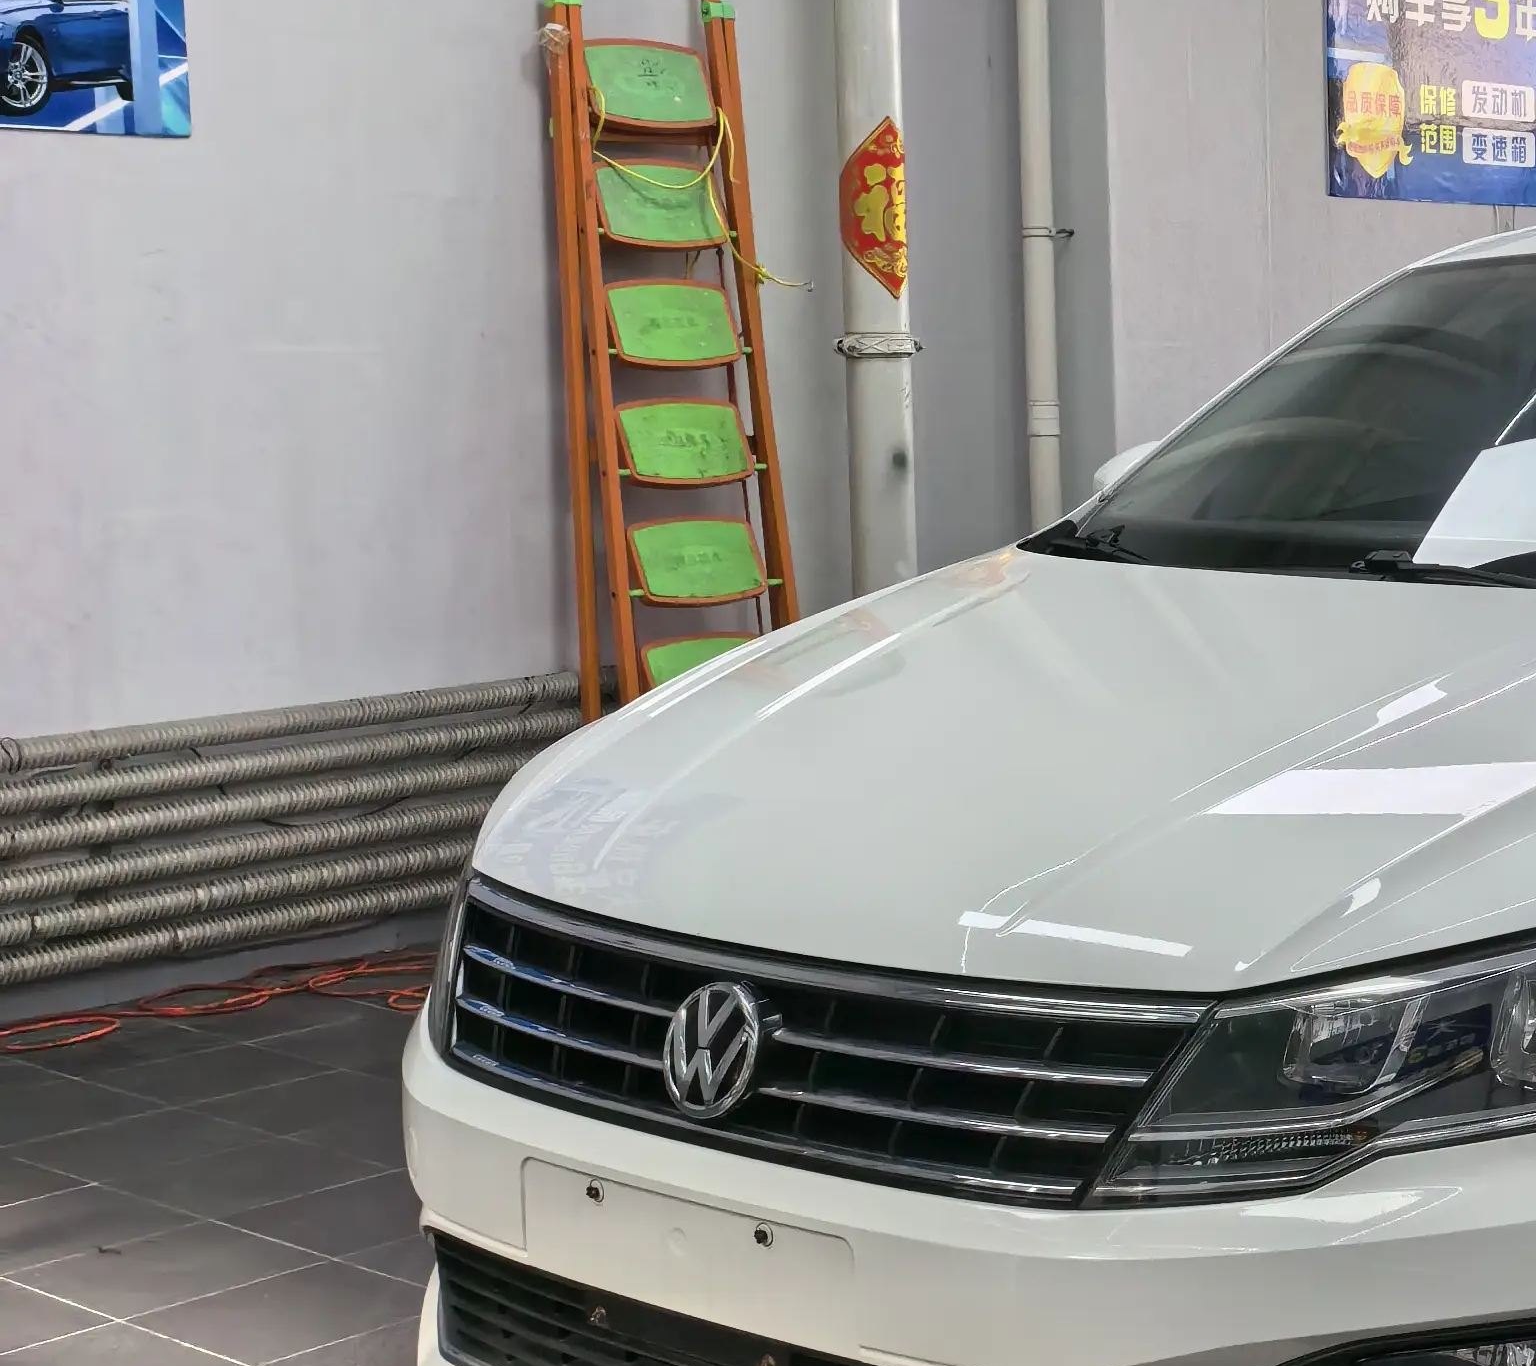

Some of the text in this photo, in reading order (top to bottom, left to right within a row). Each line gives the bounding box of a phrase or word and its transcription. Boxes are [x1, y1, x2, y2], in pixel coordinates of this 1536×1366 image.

[1346, 90, 1402, 118] 品质保障
[1420, 84, 1457, 116] 保修
[1471, 85, 1528, 118] 发动机
[1420, 123, 1457, 154] 范围
[1471, 133, 1528, 164] 变速箱
